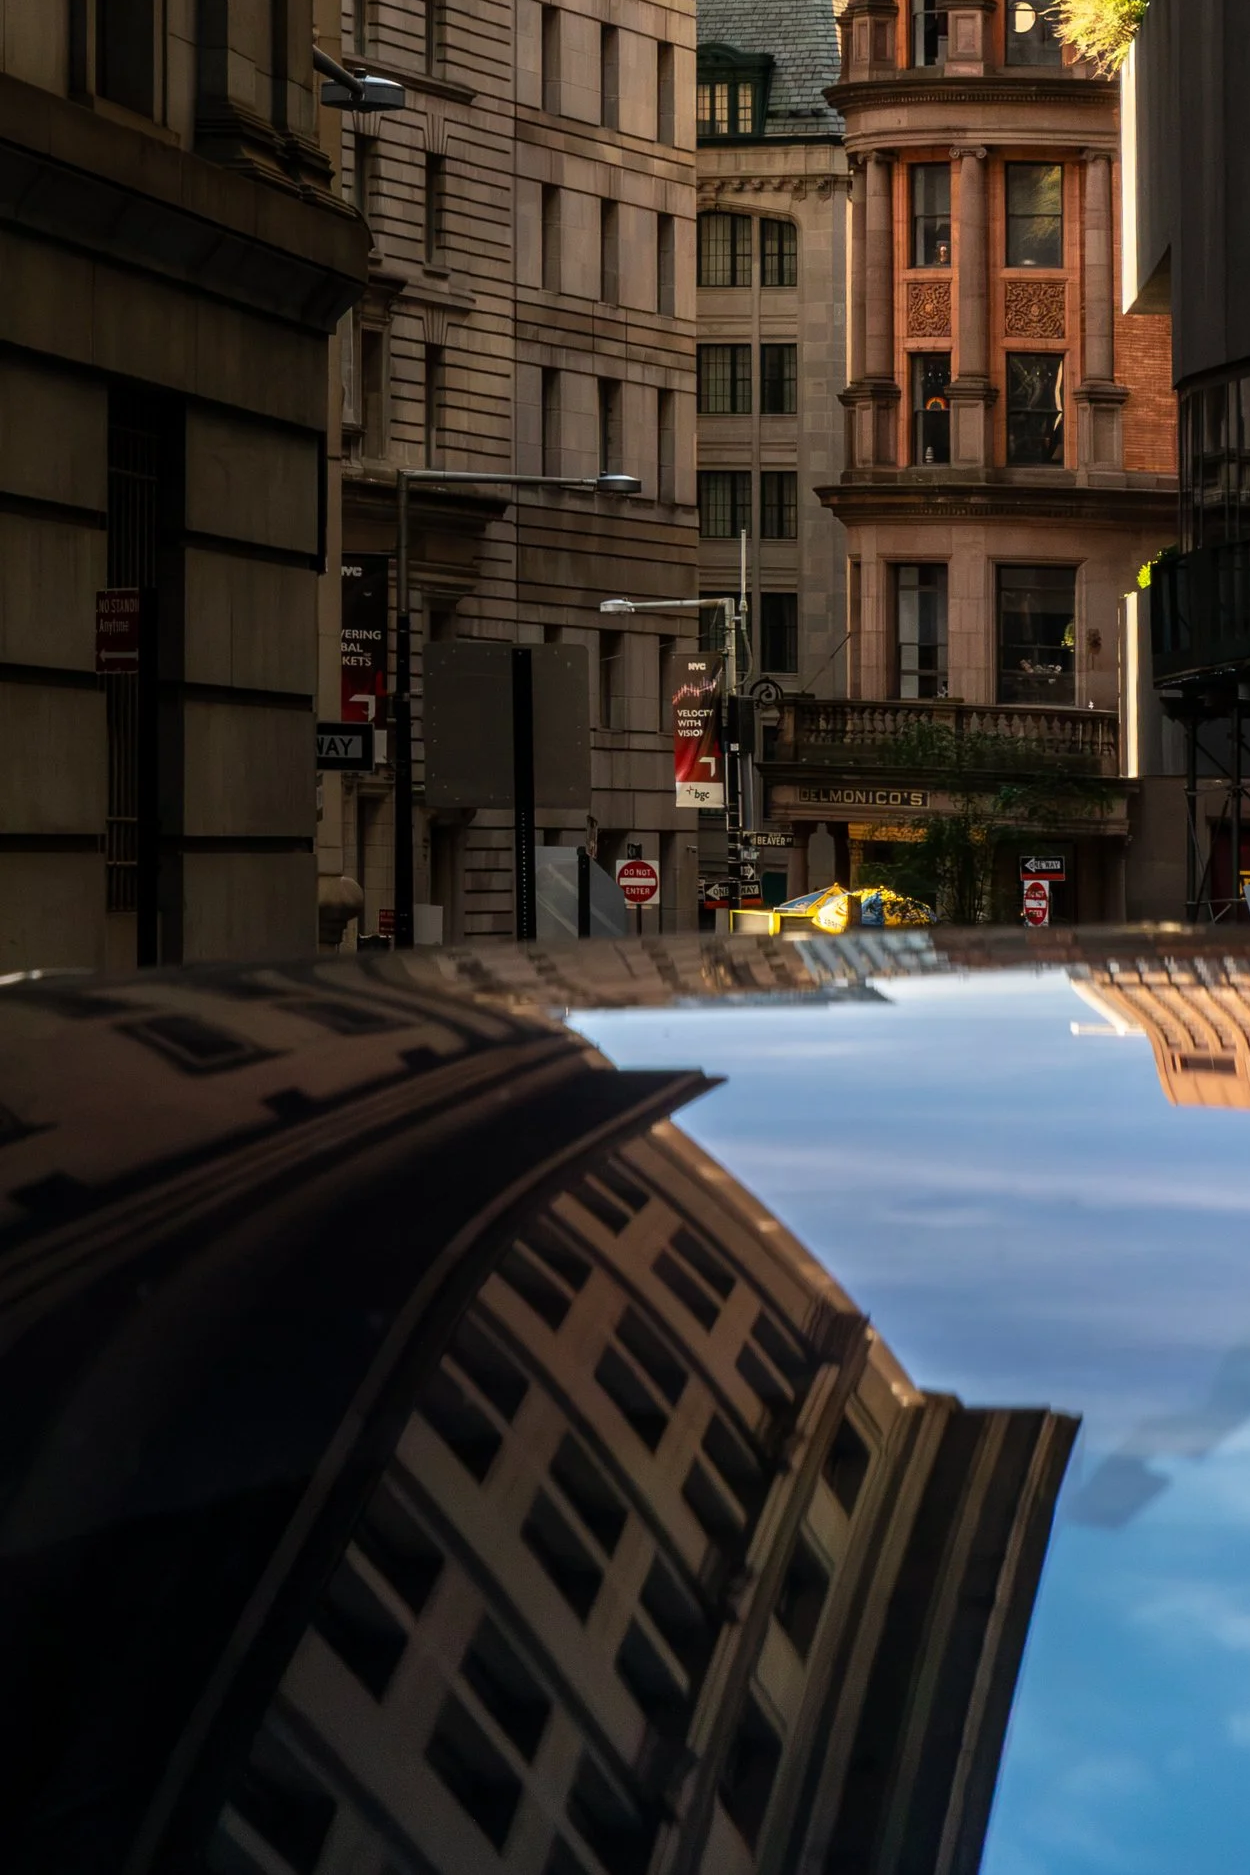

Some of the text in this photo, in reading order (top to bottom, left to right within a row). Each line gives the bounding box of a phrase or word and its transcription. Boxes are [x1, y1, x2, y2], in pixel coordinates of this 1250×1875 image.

[99, 599, 110, 613] NO
[99, 618, 131, 636] Anytime
[687, 662, 707, 671] NYC
[677, 709, 714, 718] VELOCITY
[694, 789, 710, 802] bgc
[800, 788, 923, 806] DELMONICO'S
[757, 836, 786, 845] BEAVER
[623, 868, 651, 876] DO NOT
[625, 887, 651, 895] ENTER
[712, 887, 729, 896] ONE
